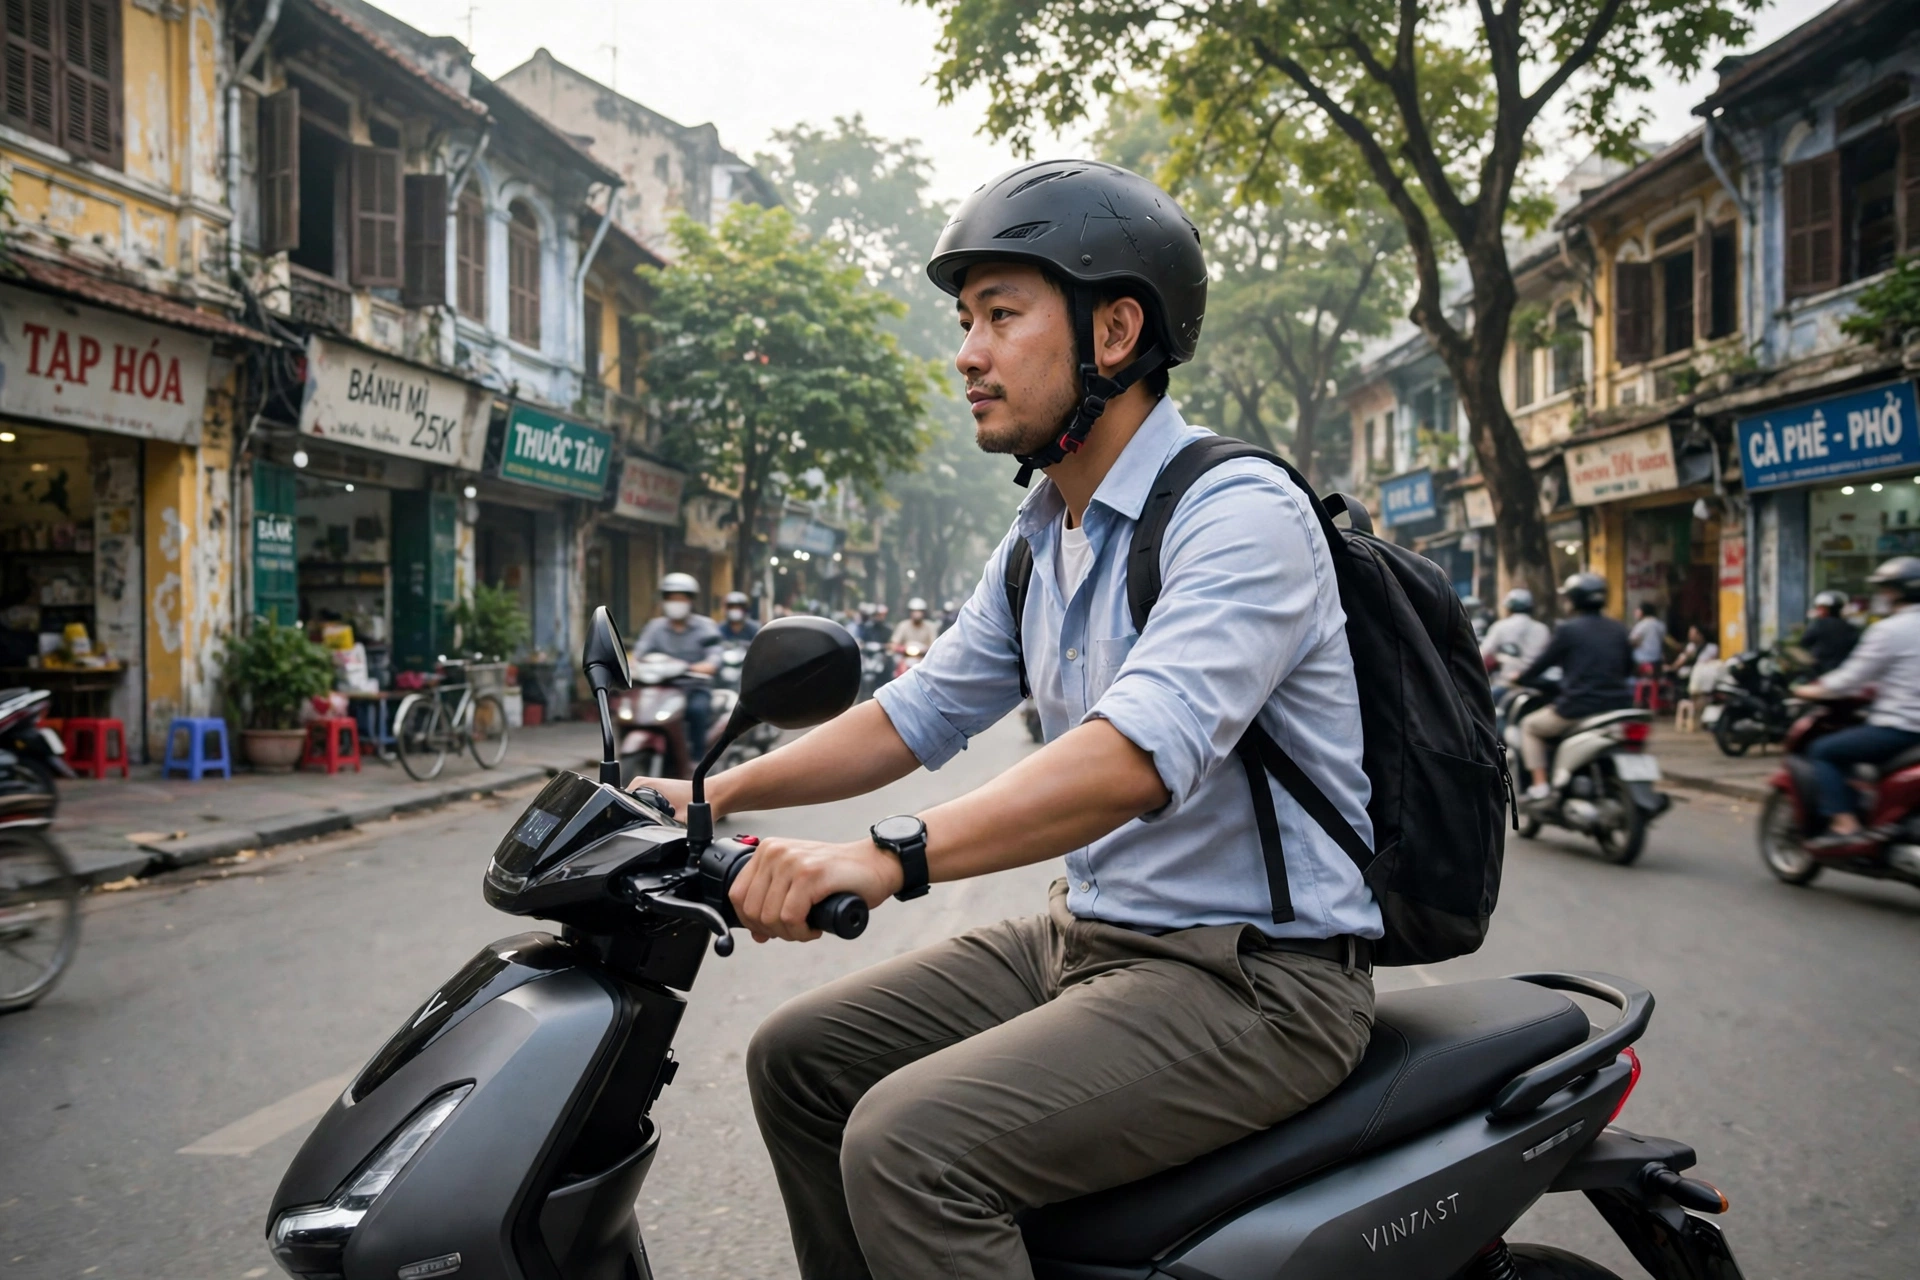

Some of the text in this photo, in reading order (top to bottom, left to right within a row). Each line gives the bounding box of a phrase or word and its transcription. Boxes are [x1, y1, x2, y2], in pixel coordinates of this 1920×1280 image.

[23, 322, 184, 405] TẠP HÓA
[347, 362, 430, 416] BÁNH MÌ
[410, 411, 456, 453] 25K
[514, 422, 604, 475] THUỐC TÂY
[1749, 420, 1781, 469] CÀ
[1782, 408, 1829, 463] PHÊ
[1832, 432, 1844, 443] -
[1847, 390, 1903, 451] PHỞ
